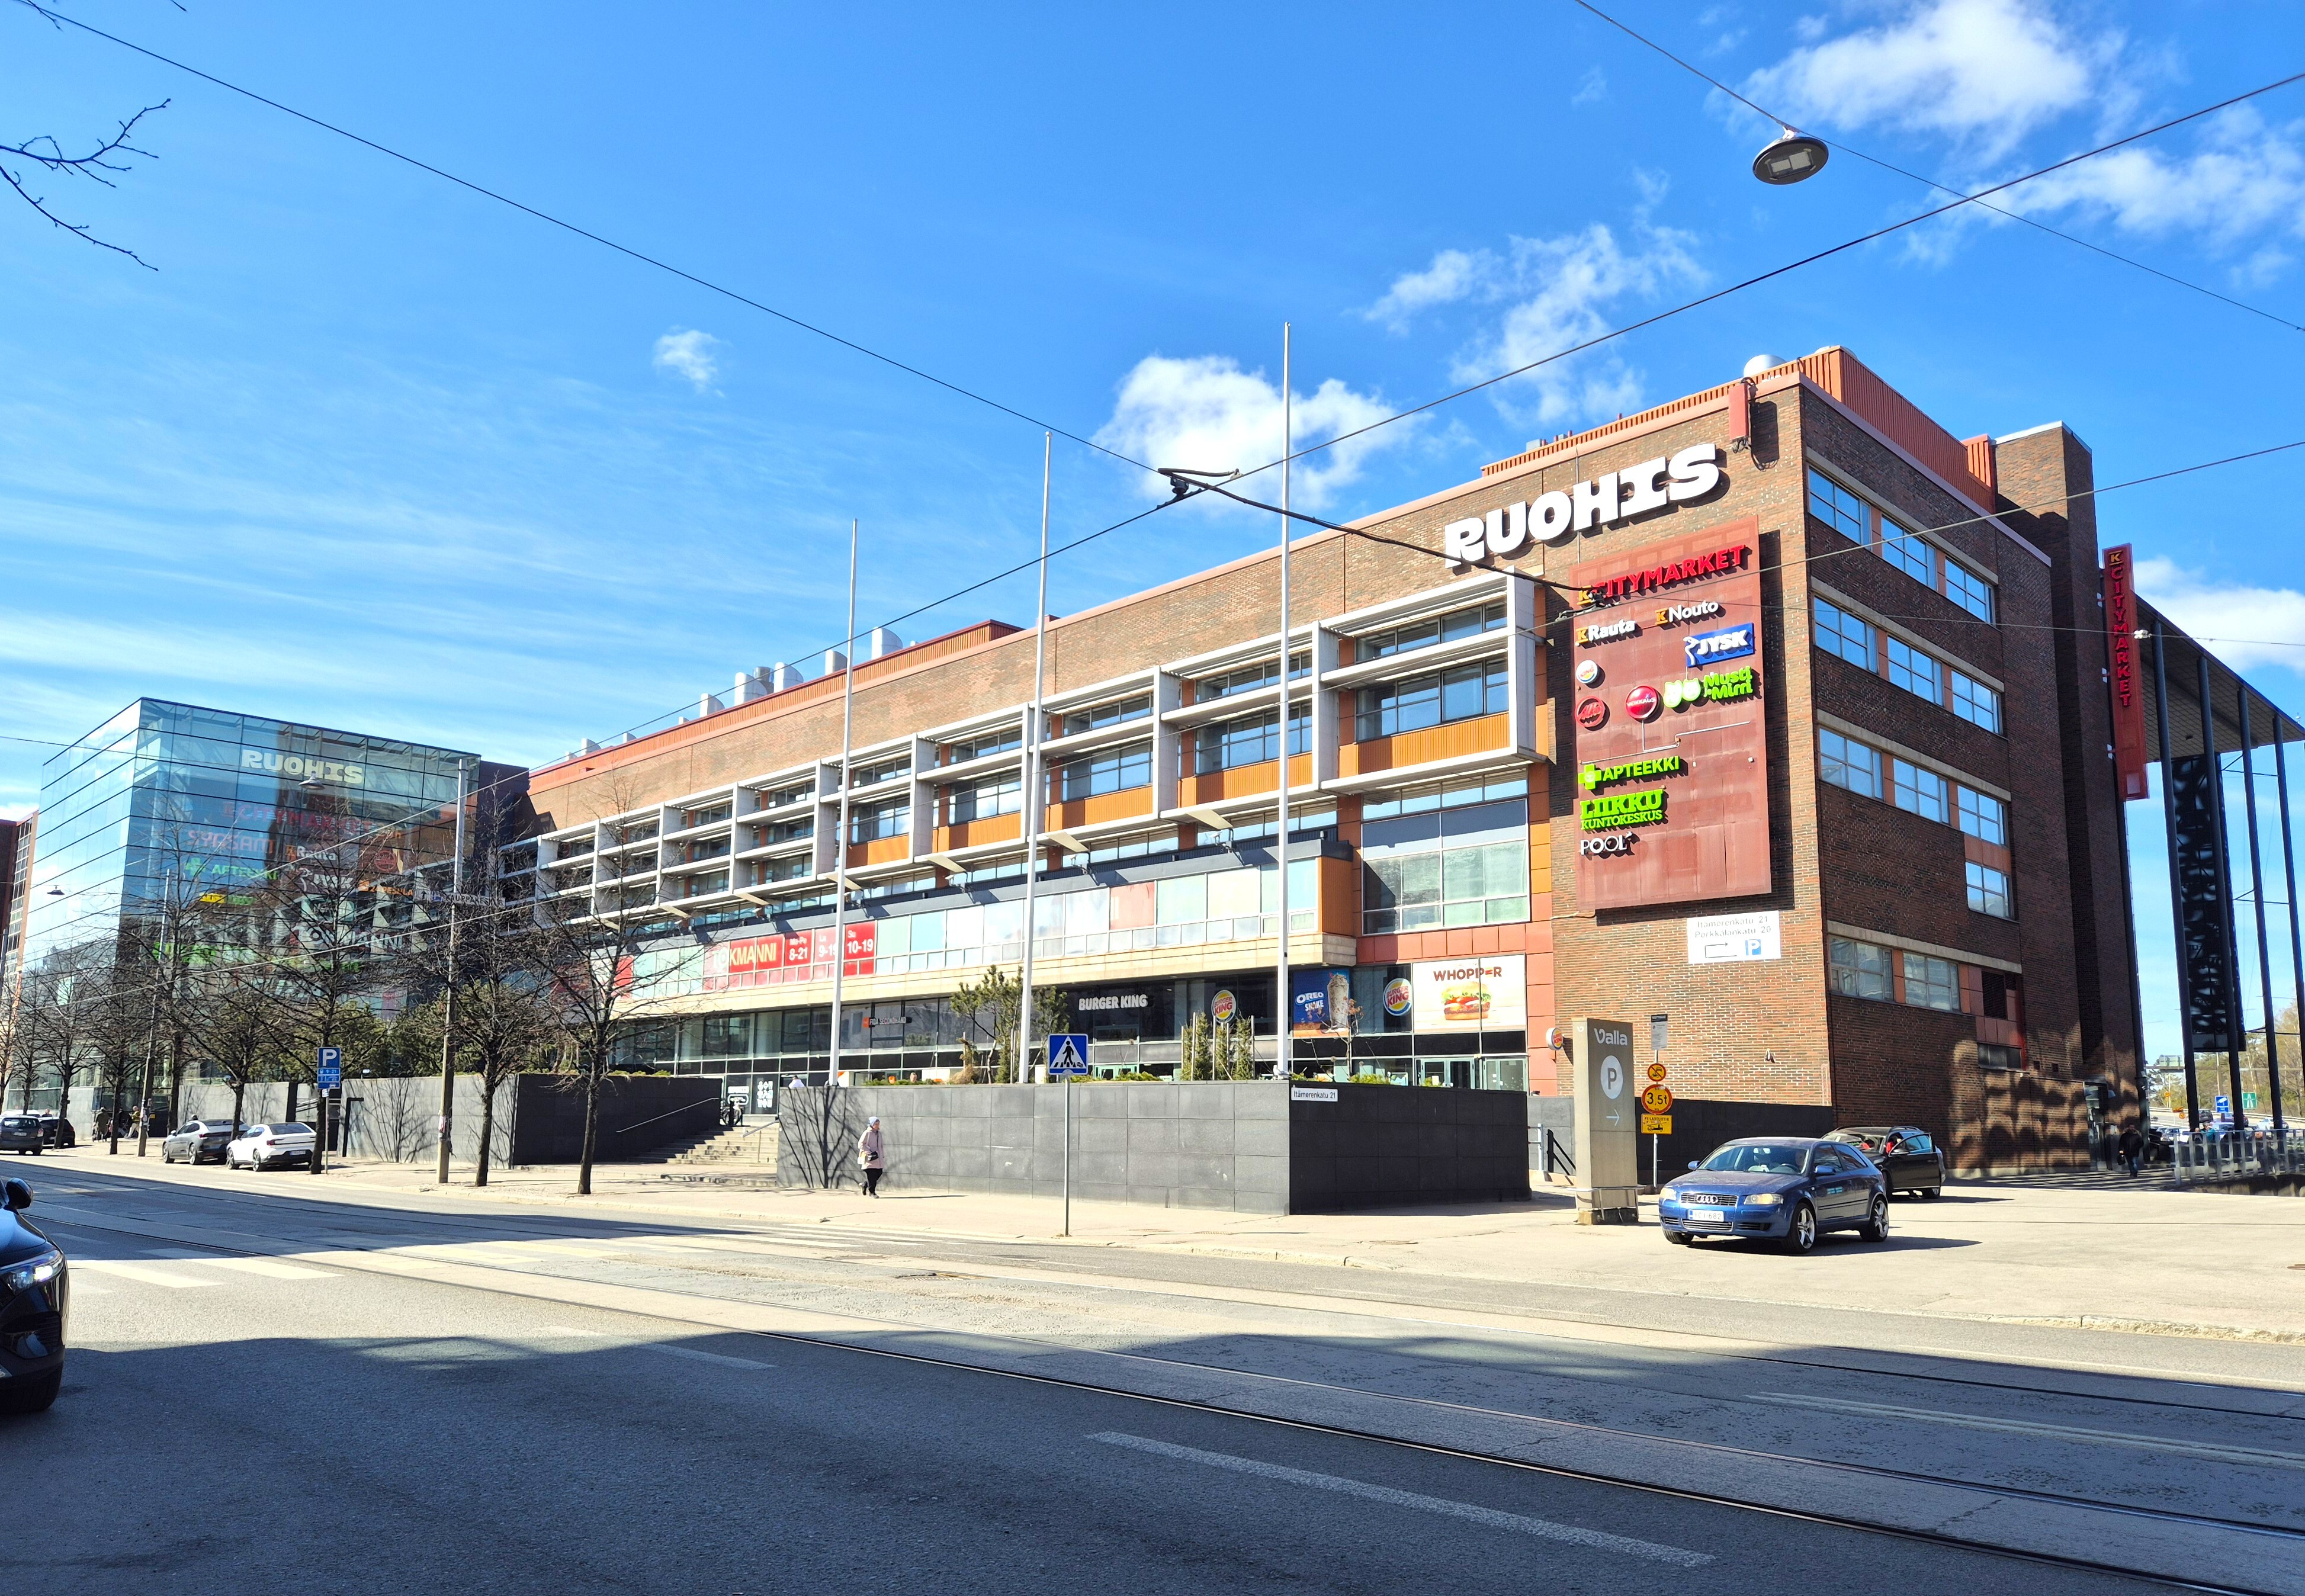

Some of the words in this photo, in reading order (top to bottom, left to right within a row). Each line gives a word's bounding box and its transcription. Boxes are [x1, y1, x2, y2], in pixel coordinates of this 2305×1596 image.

[1445, 443, 1719, 569] RUOHIS
[2109, 551, 2123, 566] K
[1668, 600, 1719, 622] Nouto
[1588, 620, 1636, 641] Rauta
[2111, 567, 2132, 707] CITYMARKET
[1697, 630, 1749, 655] JYSK
[1703, 666, 1753, 688] Musti
[241, 749, 362, 784] RUOHIS
[1603, 756, 1680, 781] APTEEKKI
[1580, 789, 1663, 820] LIIKKU
[1581, 810, 1663, 830] KUNTOKESKUS
[1580, 834, 1627, 855] POOL
[1695, 928, 1756, 938] Porkkalankatu
[712, 942, 777, 969] TOKMANNI
[789, 947, 808, 961] 8-21
[847, 939, 874, 954] 10-19
[1748, 939, 1760, 955] P
[1296, 991, 1324, 1004] OREO
[1386, 985, 1408, 998] BURGER
[1387, 992, 1410, 1007] KING
[1078, 996, 1120, 1010] BURGER
[1121, 994, 1148, 1008] KING
[1215, 1002, 1232, 1014] KING
[1594, 1027, 1627, 1046] Valla
[323, 1049, 337, 1067] P
[1607, 1067, 1617, 1090] P
[1293, 1090, 1328, 1099] Itämerenkatu
